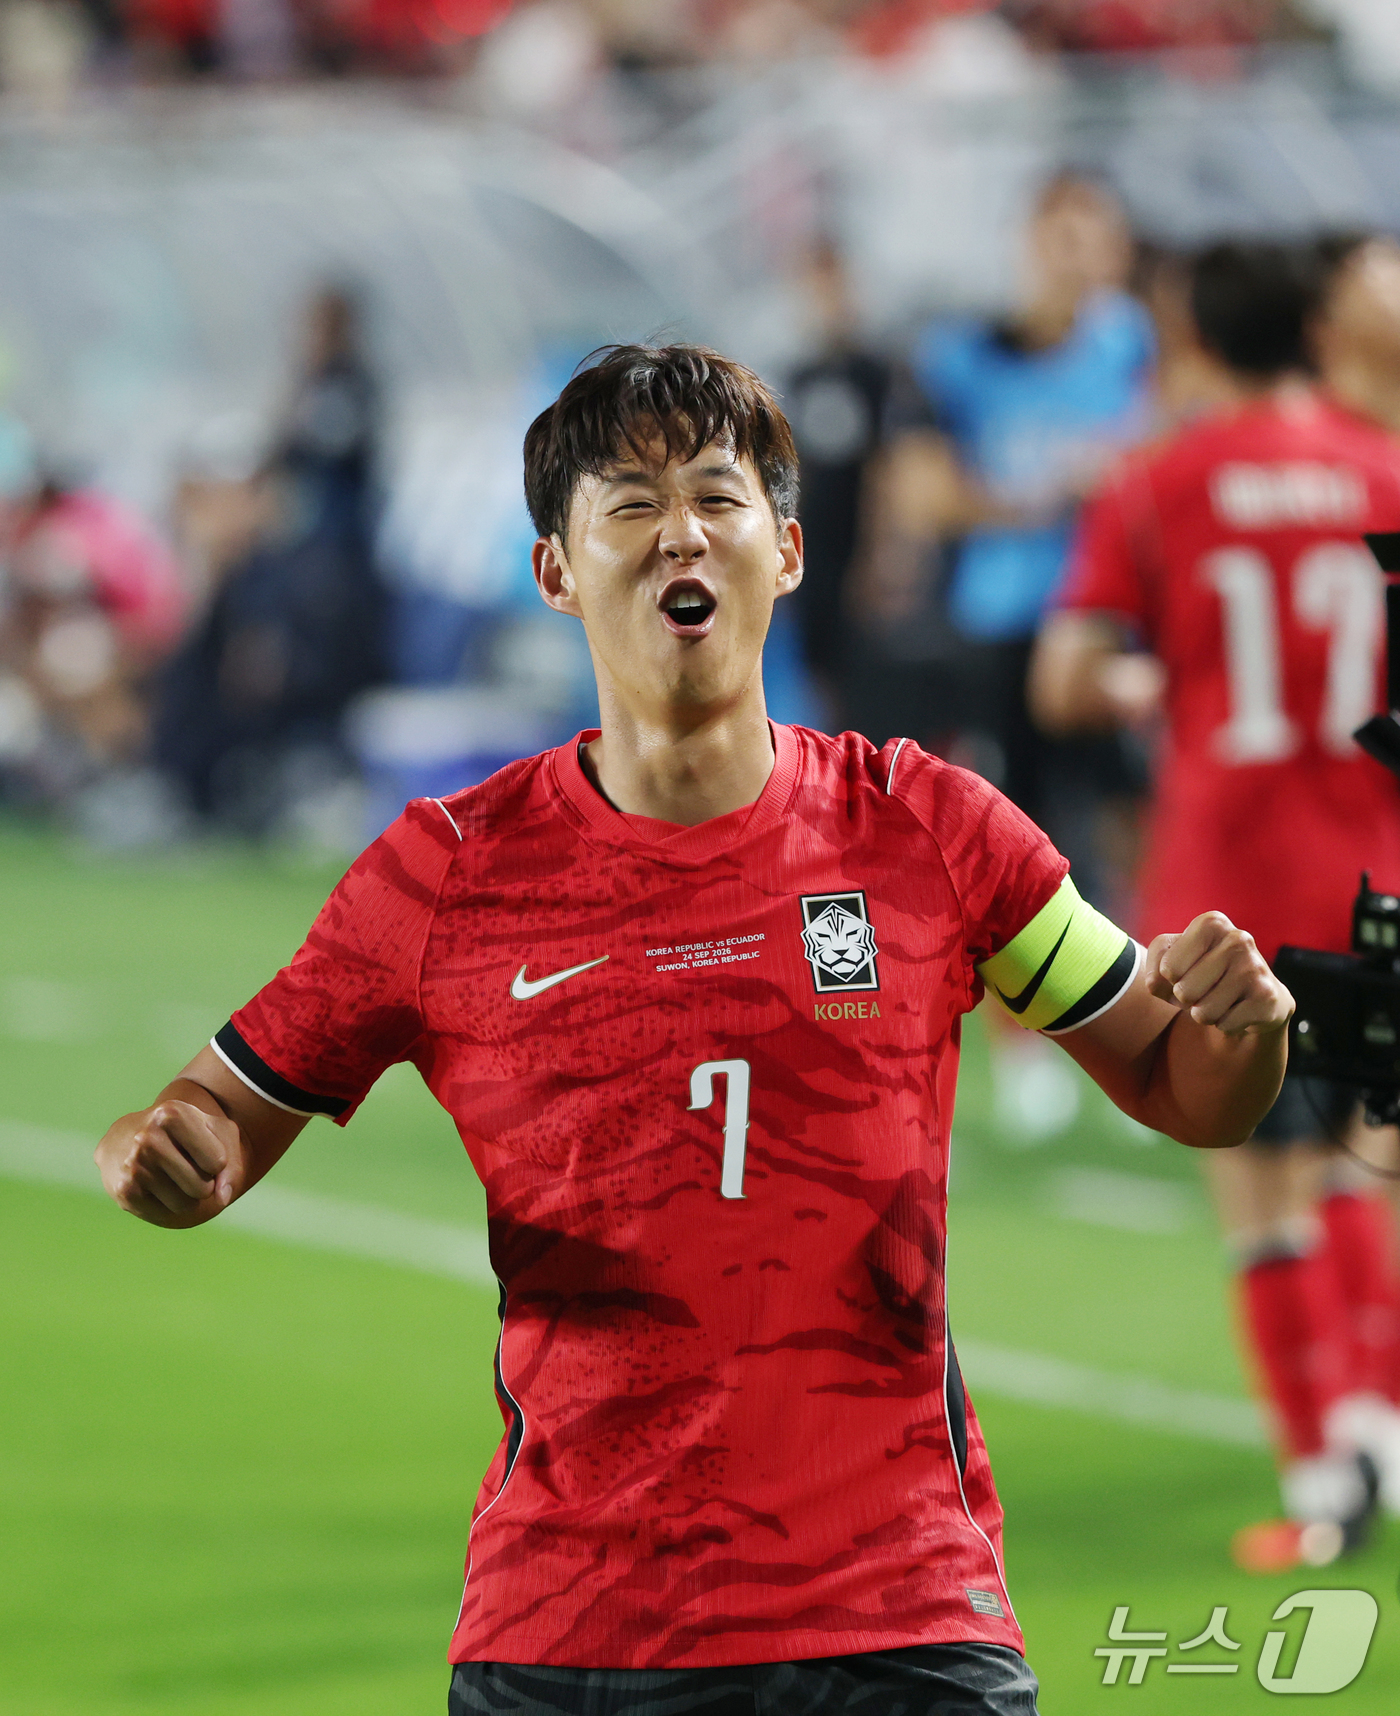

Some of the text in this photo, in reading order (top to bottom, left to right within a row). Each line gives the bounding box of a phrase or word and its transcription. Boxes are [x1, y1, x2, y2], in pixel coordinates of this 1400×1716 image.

[645, 947, 673, 957] KOREA
[675, 941, 714, 953] REPUBLIC
[726, 933, 765, 946] ECUADOR
[682, 947, 732, 961] 24 SEP 2026
[656, 951, 760, 972] SUWON, KOREA REPUBLIC
[814, 1001, 881, 1020] KOREA
[686, 1058, 751, 1199] 7
